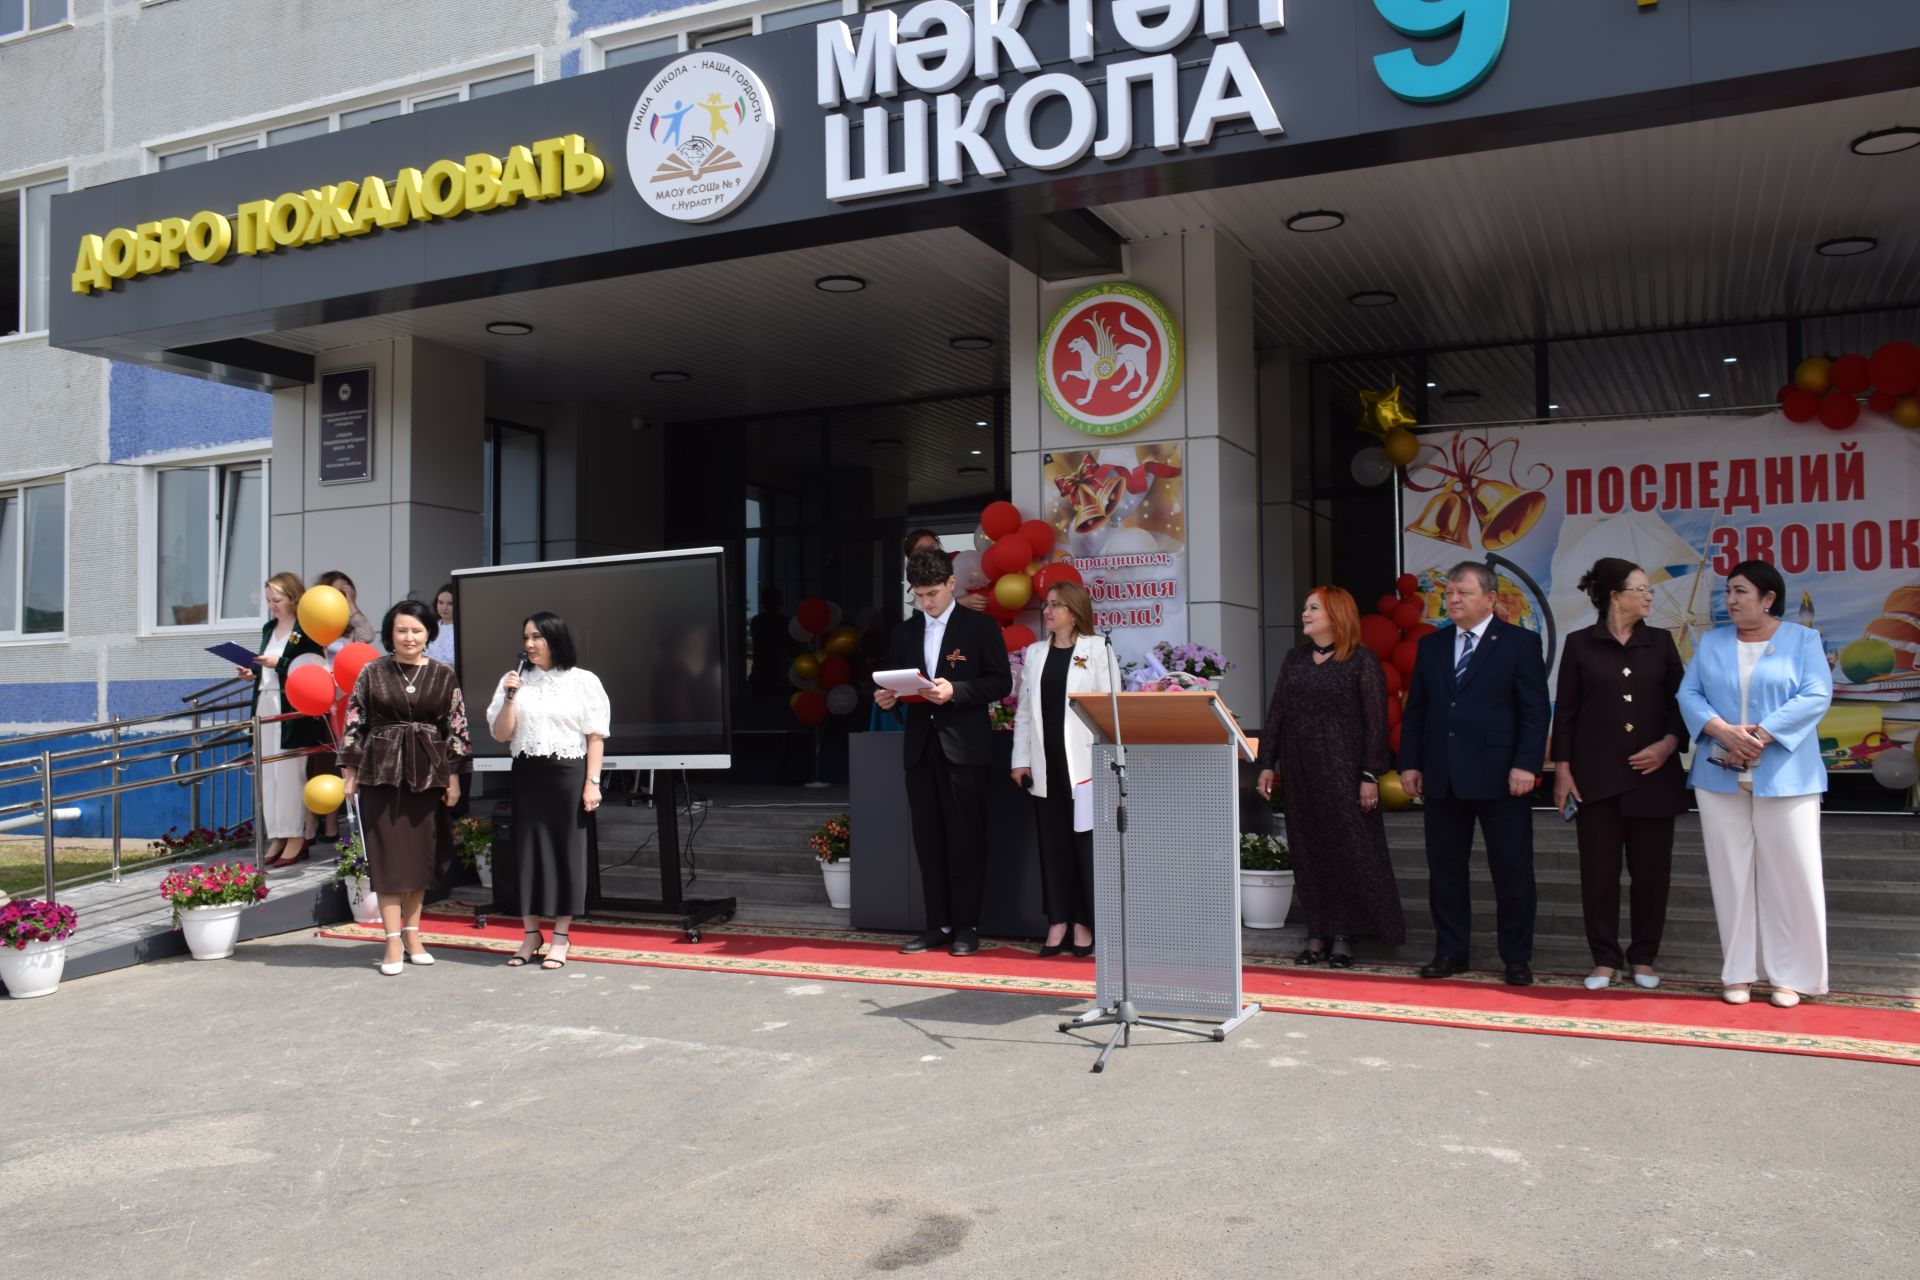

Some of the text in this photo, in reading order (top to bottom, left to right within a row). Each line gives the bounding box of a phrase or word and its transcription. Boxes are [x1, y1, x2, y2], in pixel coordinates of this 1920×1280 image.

[634, 97, 653, 130] НАША
[653, 65, 688, 93] ШКОЛА
[702, 60, 730, 74] НАША
[731, 70, 762, 122] ГОРДОСТЬ
[825, 41, 1284, 203] ШКОЛА
[72, 134, 604, 294] ДОБРО ПОЖАЛОВАТЬ
[656, 177, 741, 200] МАОУ «СОШ» № 9
[672, 194, 724, 211] г.Нурлат РТ
[1566, 441, 1865, 515] ПОСЛЕДНИЙ
[1075, 553, 1171, 571] праздником,
[1712, 519, 1920, 576] ЗВОНОК
[1092, 603, 1163, 627] кола!
